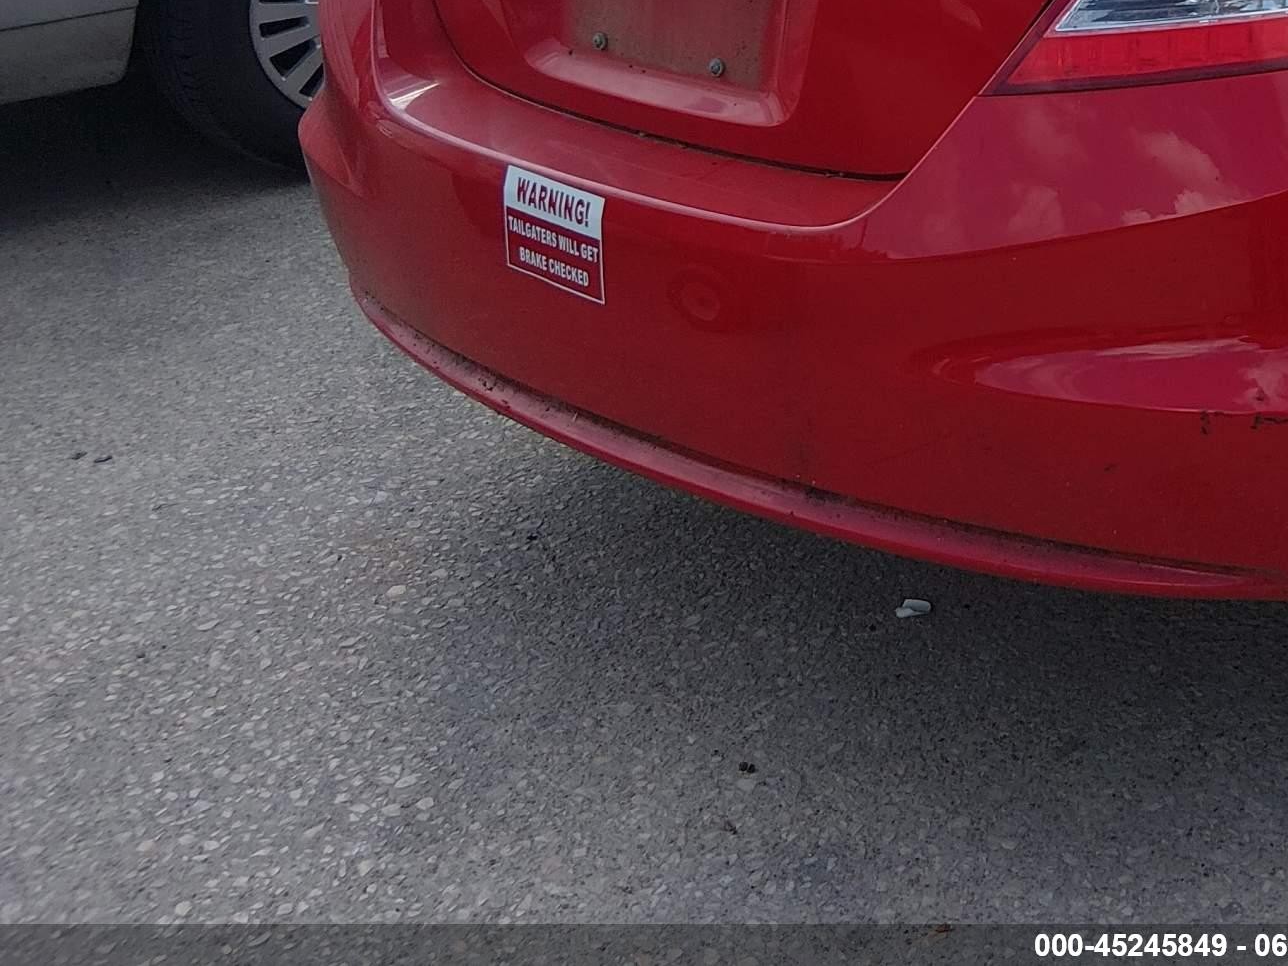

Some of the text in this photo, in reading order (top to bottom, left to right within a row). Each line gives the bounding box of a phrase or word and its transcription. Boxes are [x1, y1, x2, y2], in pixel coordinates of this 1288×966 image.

[517, 176, 591, 228] WARNING!
[508, 215, 599, 263] TAILGATERS WILL GET
[519, 246, 589, 287] BRAKE CHECKED
